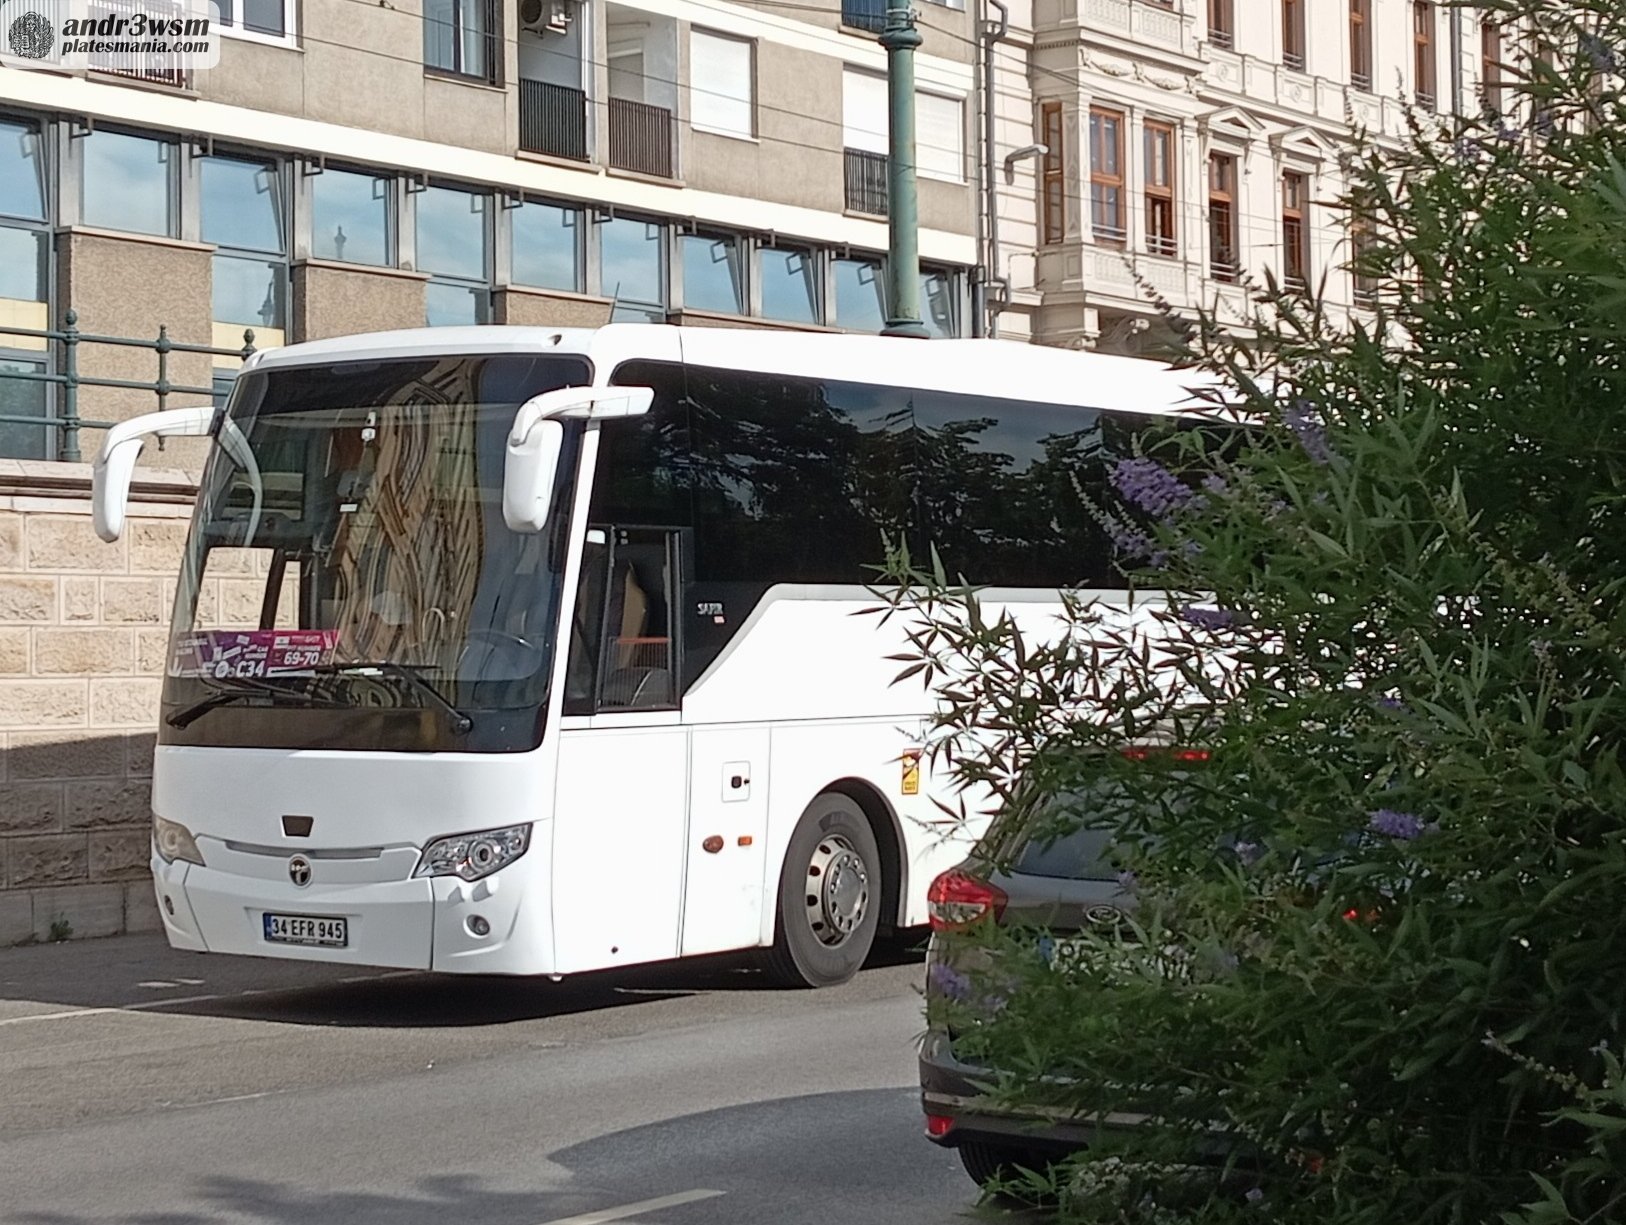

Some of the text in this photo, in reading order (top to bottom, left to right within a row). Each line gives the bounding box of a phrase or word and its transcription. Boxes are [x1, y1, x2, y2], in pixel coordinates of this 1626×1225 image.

[284, 651, 320, 665] 69-70
[236, 660, 265, 677] C34
[272, 918, 287, 935] 34
[291, 920, 315, 936] EFR
[319, 922, 343, 939] 945
